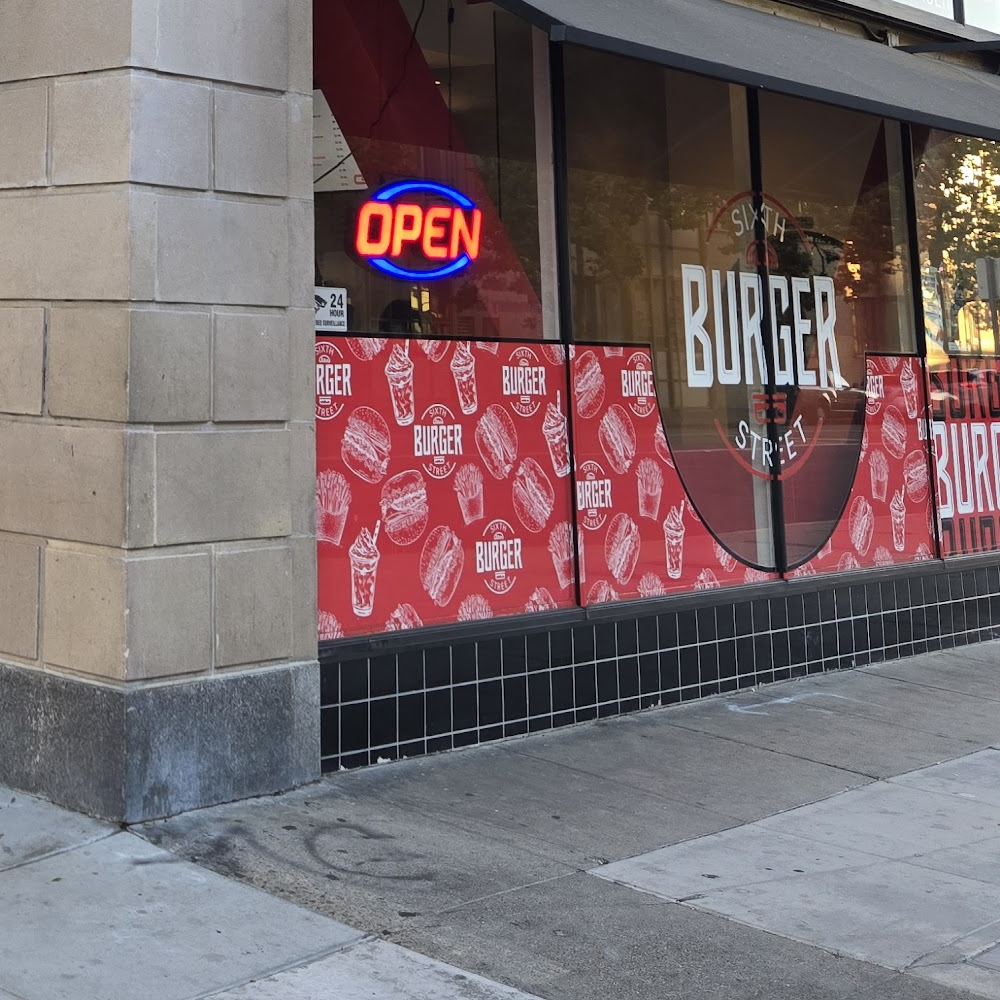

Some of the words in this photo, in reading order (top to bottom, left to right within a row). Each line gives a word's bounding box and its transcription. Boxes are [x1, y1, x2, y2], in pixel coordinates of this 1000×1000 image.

[355, 200, 483, 261] OPEN
[731, 203, 787, 243] SIXTH
[330, 293, 344, 309] 24
[330, 309, 344, 318] HOUR
[681, 263, 843, 389] BURGER
[515, 350, 532, 360] SIXTH
[633, 354, 647, 364] SIXTH
[316, 363, 352, 396] RGER
[502, 365, 547, 396] BURGER
[621, 370, 656, 397] BURGE
[429, 407, 447, 418] SIXTH
[515, 401, 537, 414] STREET
[634, 402, 652, 414] STREET
[414, 424, 463, 457] BURGER
[734, 415, 809, 468] STREET
[427, 463, 452, 477] STREET
[583, 464, 598, 474] SIXTH
[489, 522, 508, 534] SIXTH
[584, 514, 603, 527] STREET
[476, 538, 523, 574] BURGER
[489, 577, 513, 592] STREET
